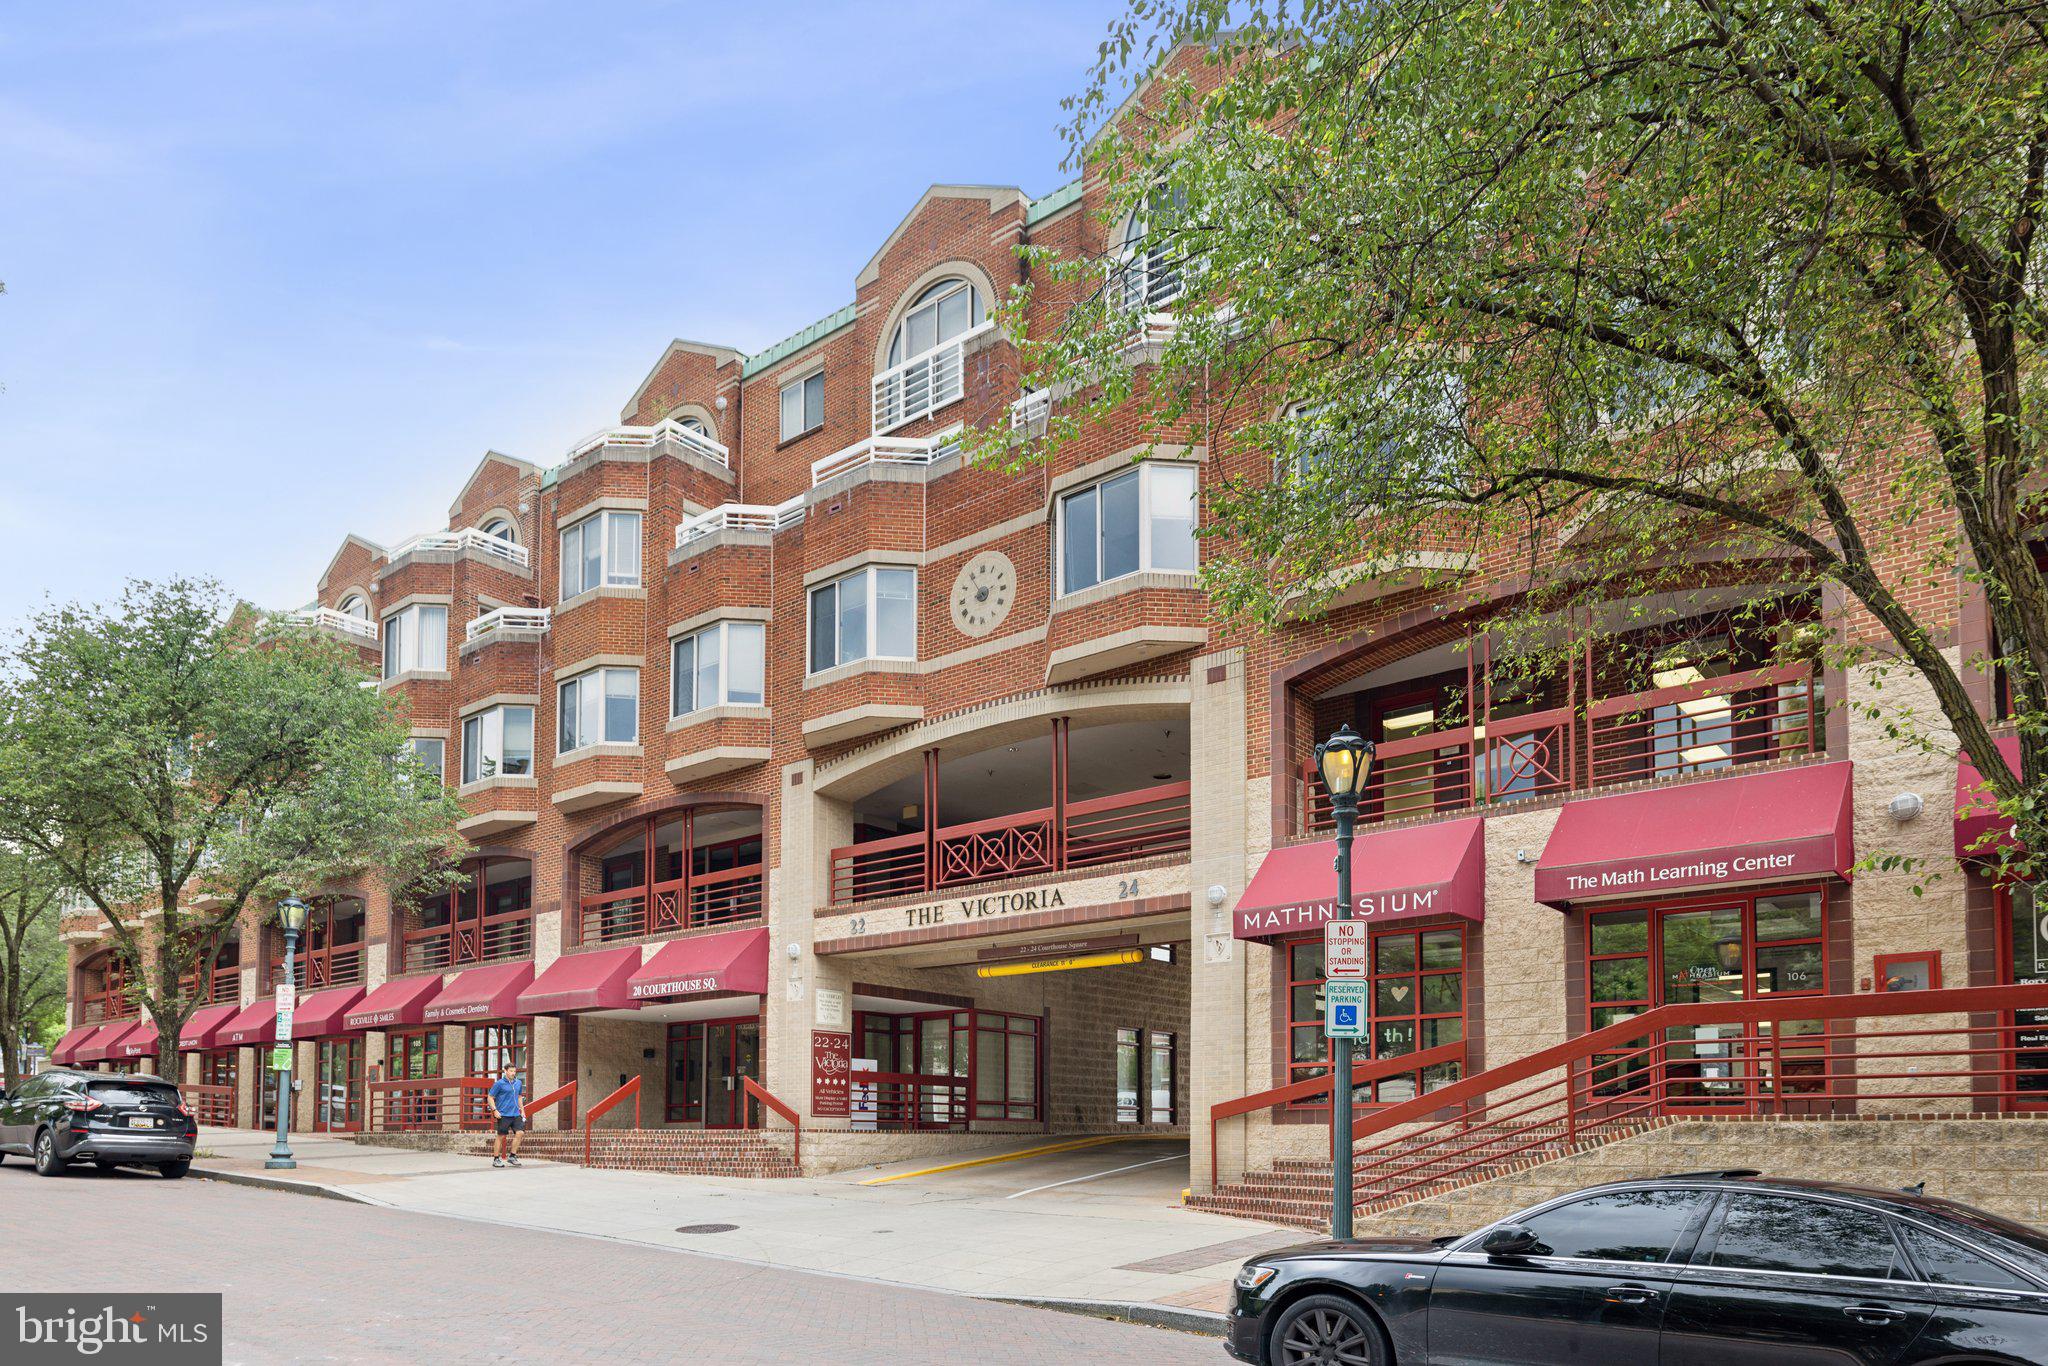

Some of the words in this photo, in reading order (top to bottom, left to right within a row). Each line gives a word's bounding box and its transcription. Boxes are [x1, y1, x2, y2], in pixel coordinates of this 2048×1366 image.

[1567, 875, 1598, 890] The
[1601, 871, 1645, 887] Math
[1650, 860, 1728, 882] Learning
[1733, 853, 1795, 873] Center
[849, 918, 866, 935] 22
[906, 905, 944, 927] THE
[960, 888, 1065, 918] VICTORIA
[1119, 879, 1139, 899] 24
[1244, 890, 1434, 930] MATHNSIUM
[1339, 925, 1354, 937] NO
[1069, 942, 1088, 950] Square
[1328, 938, 1365, 946] STOPPING
[1341, 947, 1352, 956] OR
[1031, 960, 1059, 968] CLEARANCE
[1329, 957, 1364, 966] STANDING
[1787, 972, 1807, 981] 106
[633, 986, 642, 997] 20
[643, 980, 702, 995] COURTHOUSE
[703, 978, 718, 991] SQ.
[1329, 985, 1364, 994] RESERVED
[1330, 995, 1362, 1003] PARKING
[424, 1009, 439, 1019] Family
[445, 1007, 467, 1016] Cosmetic
[467, 1004, 490, 1014] Dentistry
[350, 1014, 373, 1026] ROCKVILLE
[379, 1012, 395, 1022] SMILES
[232, 1033, 243, 1042] ATM
[825, 1051, 839, 1060] The
[815, 1056, 849, 1073] Victoria
